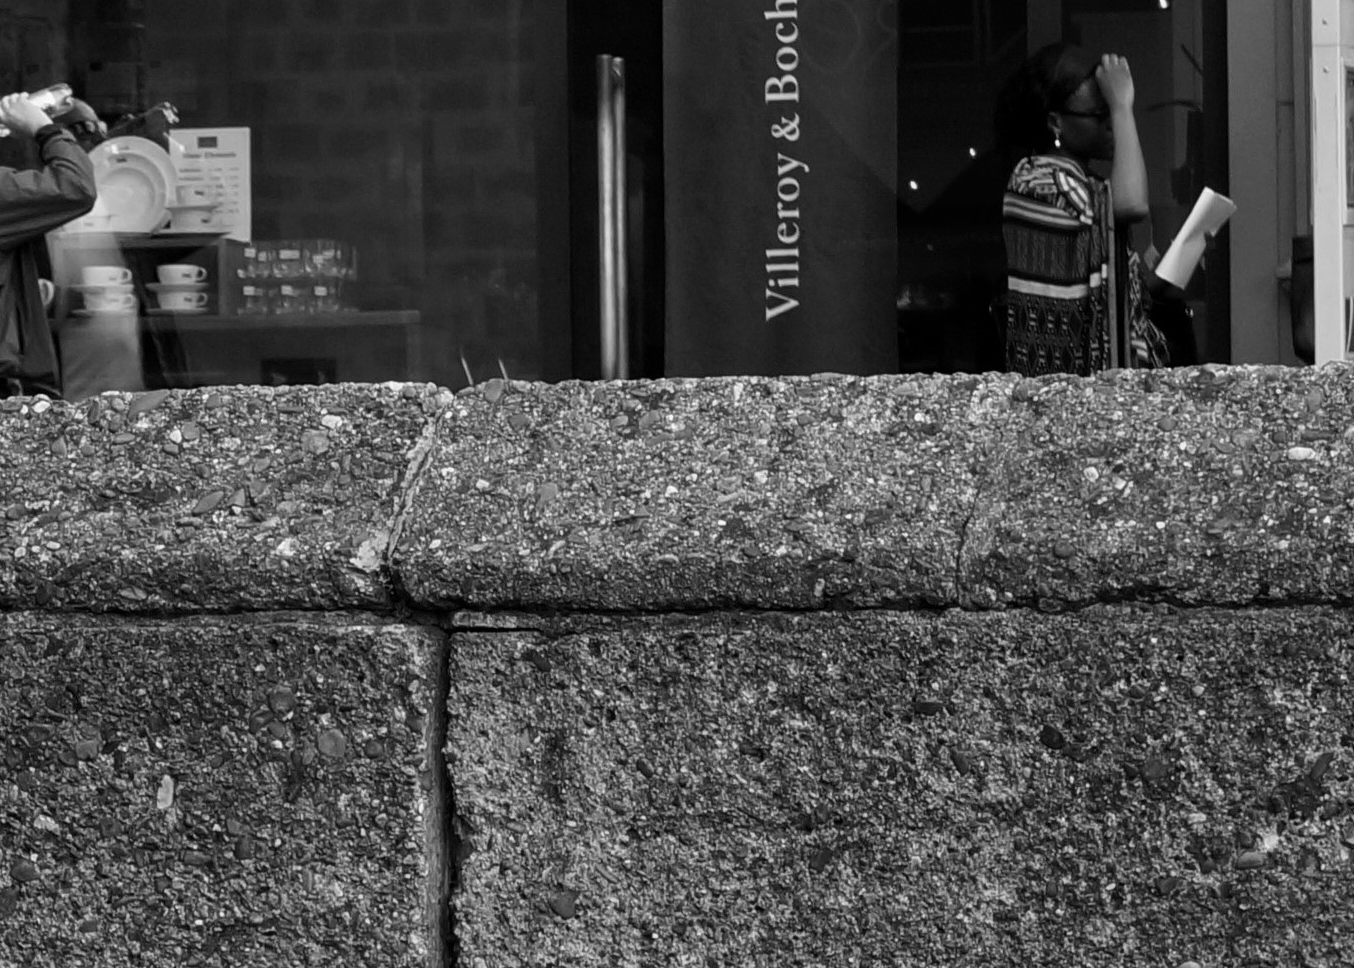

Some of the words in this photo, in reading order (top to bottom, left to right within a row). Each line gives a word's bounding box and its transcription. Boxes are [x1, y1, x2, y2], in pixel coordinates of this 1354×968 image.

[764, 0, 800, 104] Boch
[771, 112, 800, 142] &
[765, 152, 810, 322] Villeroy
